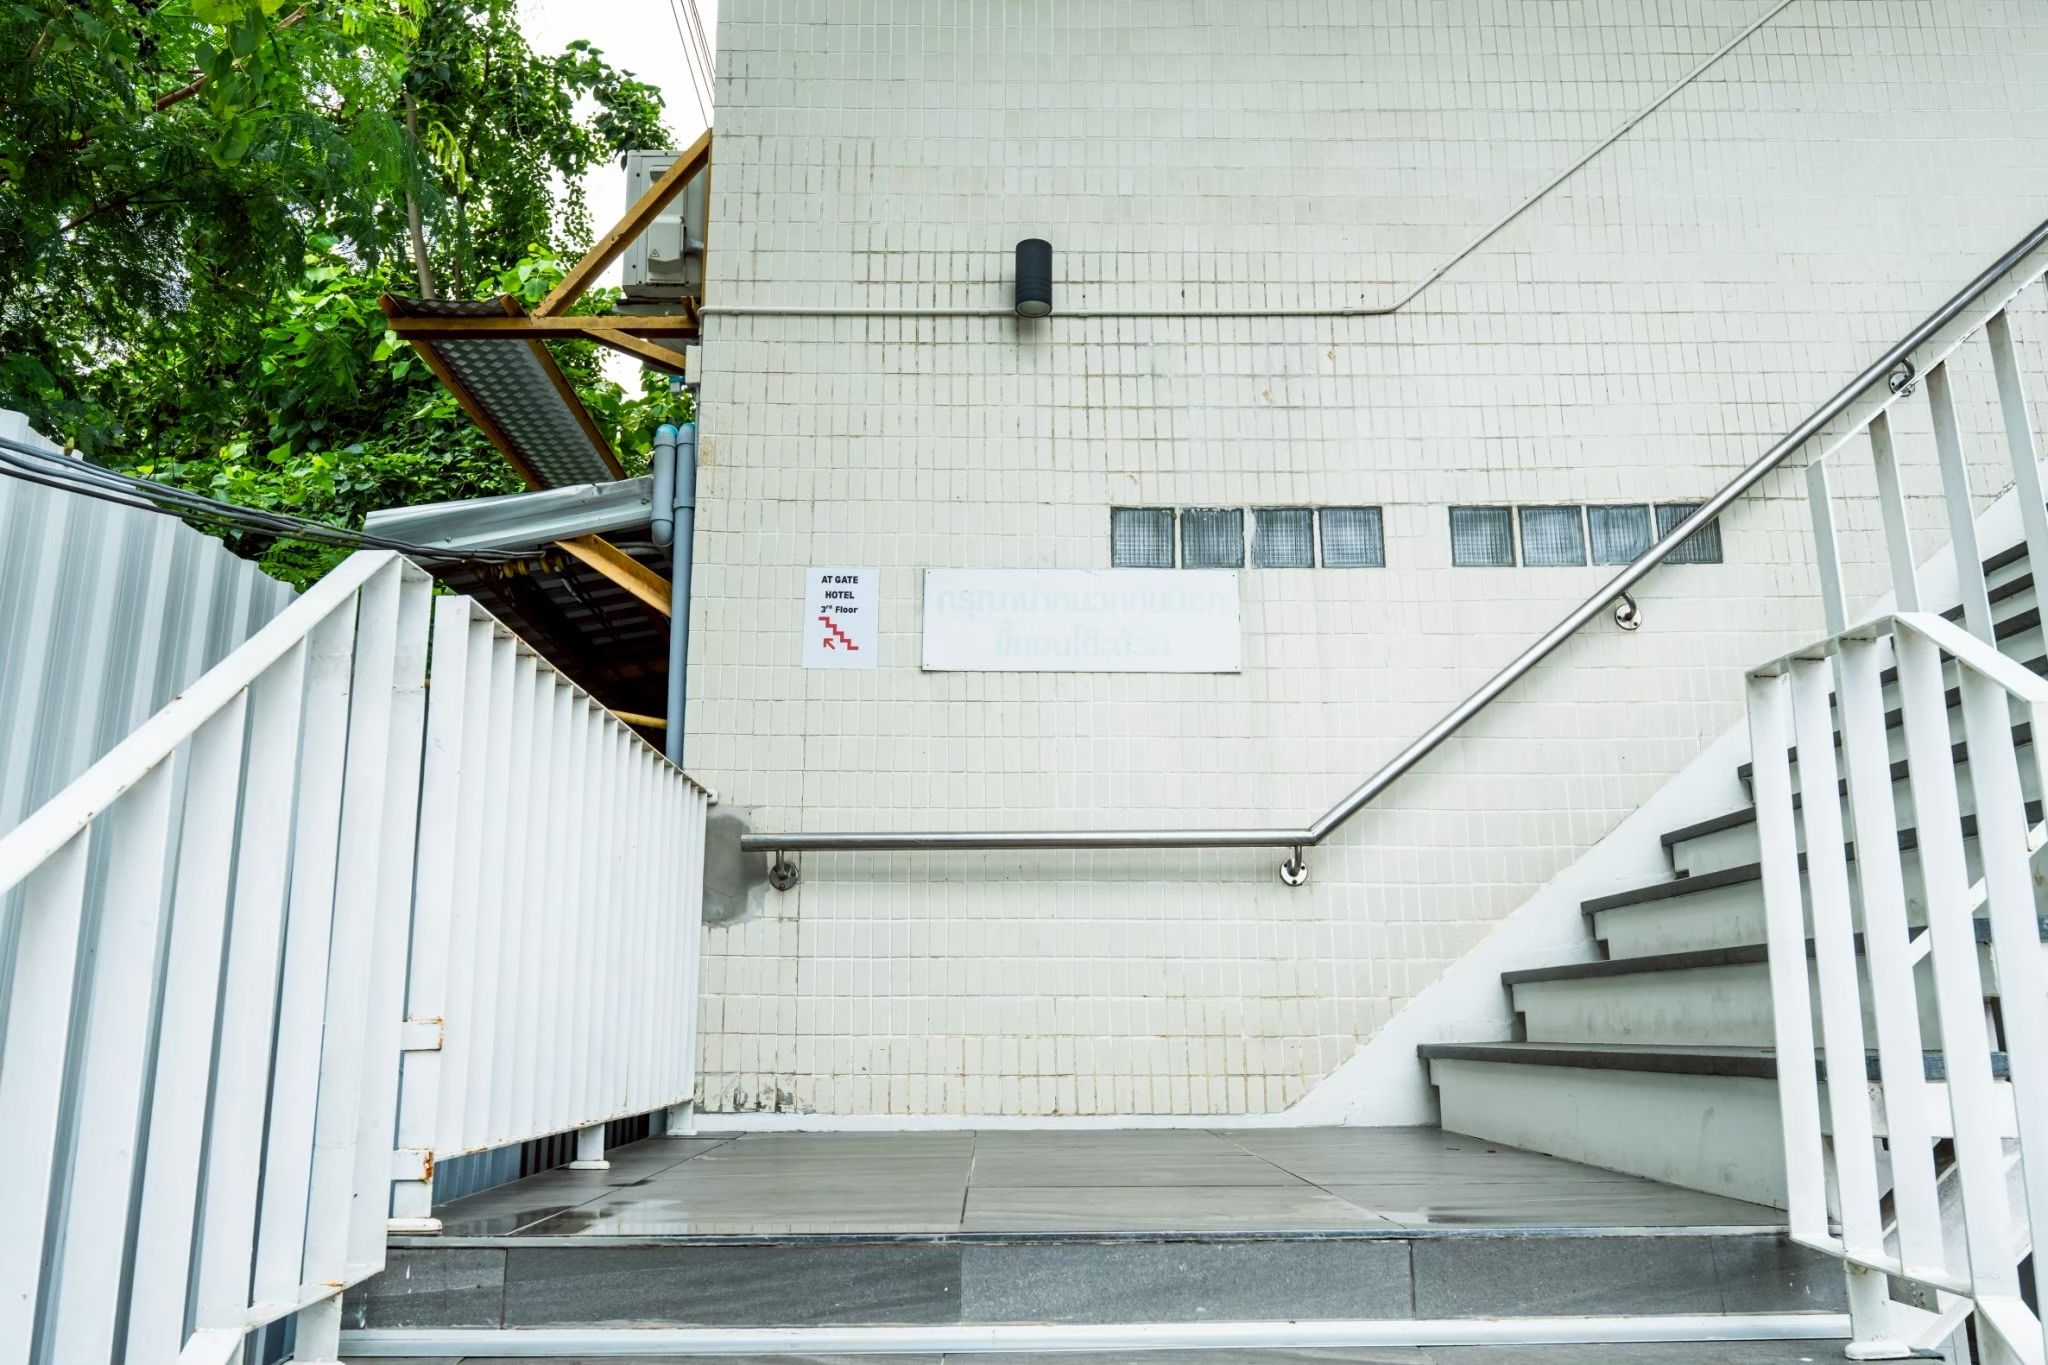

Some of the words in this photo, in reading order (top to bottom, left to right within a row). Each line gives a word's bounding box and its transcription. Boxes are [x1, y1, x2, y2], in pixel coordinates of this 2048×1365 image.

[821, 575, 833, 584] AT
[834, 575, 859, 584] GATE
[825, 590, 855, 599] HOTEL
[835, 605, 859, 614] Floor
